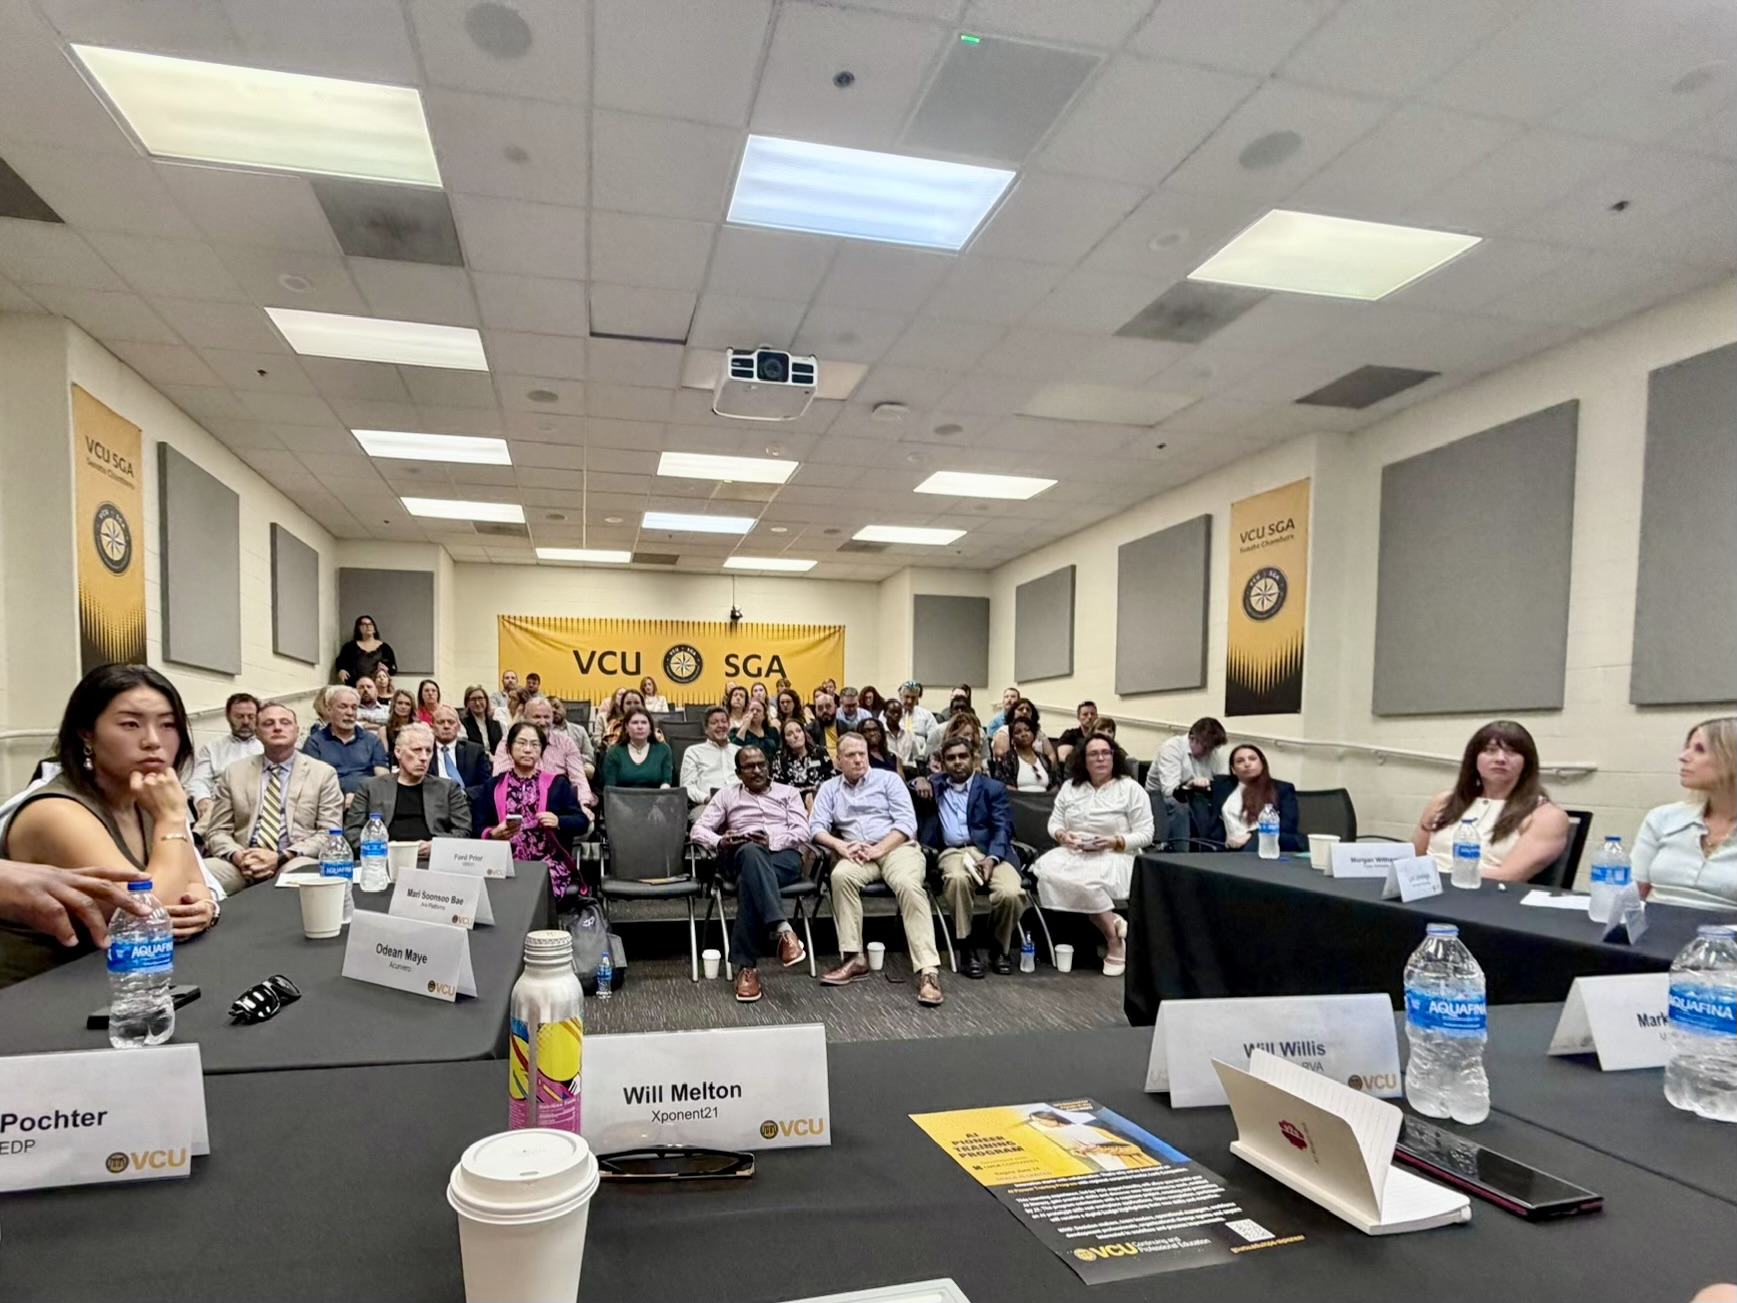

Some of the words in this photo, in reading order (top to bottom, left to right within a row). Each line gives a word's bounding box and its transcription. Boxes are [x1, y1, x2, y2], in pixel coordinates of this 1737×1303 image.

[85, 435, 111, 464] VCU
[112, 452, 135, 478] SGA
[1240, 526, 1265, 544] VCU
[1268, 518, 1295, 536] SGA
[572, 650, 641, 676] VCU
[724, 653, 787, 679] SGA
[454, 853, 468, 862] Ford
[469, 854, 483, 863] Prior
[407, 888, 421, 899] Mari
[421, 890, 450, 904] Soonsoo
[451, 895, 464, 906] Bae
[376, 943, 403, 960] Odean
[404, 948, 428, 965] Maye
[436, 982, 456, 997] VCU
[1637, 1011, 1668, 1028] Mark
[1279, 1040, 1326, 1057] Willis
[1365, 1073, 1397, 1089] VCU
[623, 1085, 663, 1105] Will
[671, 1081, 742, 1103] Melton
[0, 1109, 108, 1133] Pochter
[651, 1106, 719, 1125] Xponent21
[779, 1118, 824, 1137] VCU
[951, 1135, 1006, 1146] PIONEER
[952, 1141, 1017, 1152] TRAINING
[130, 1147, 186, 1170] VCU
[958, 1146, 1025, 1158] PROGRAM
[1089, 1242, 1139, 1258] VCU
